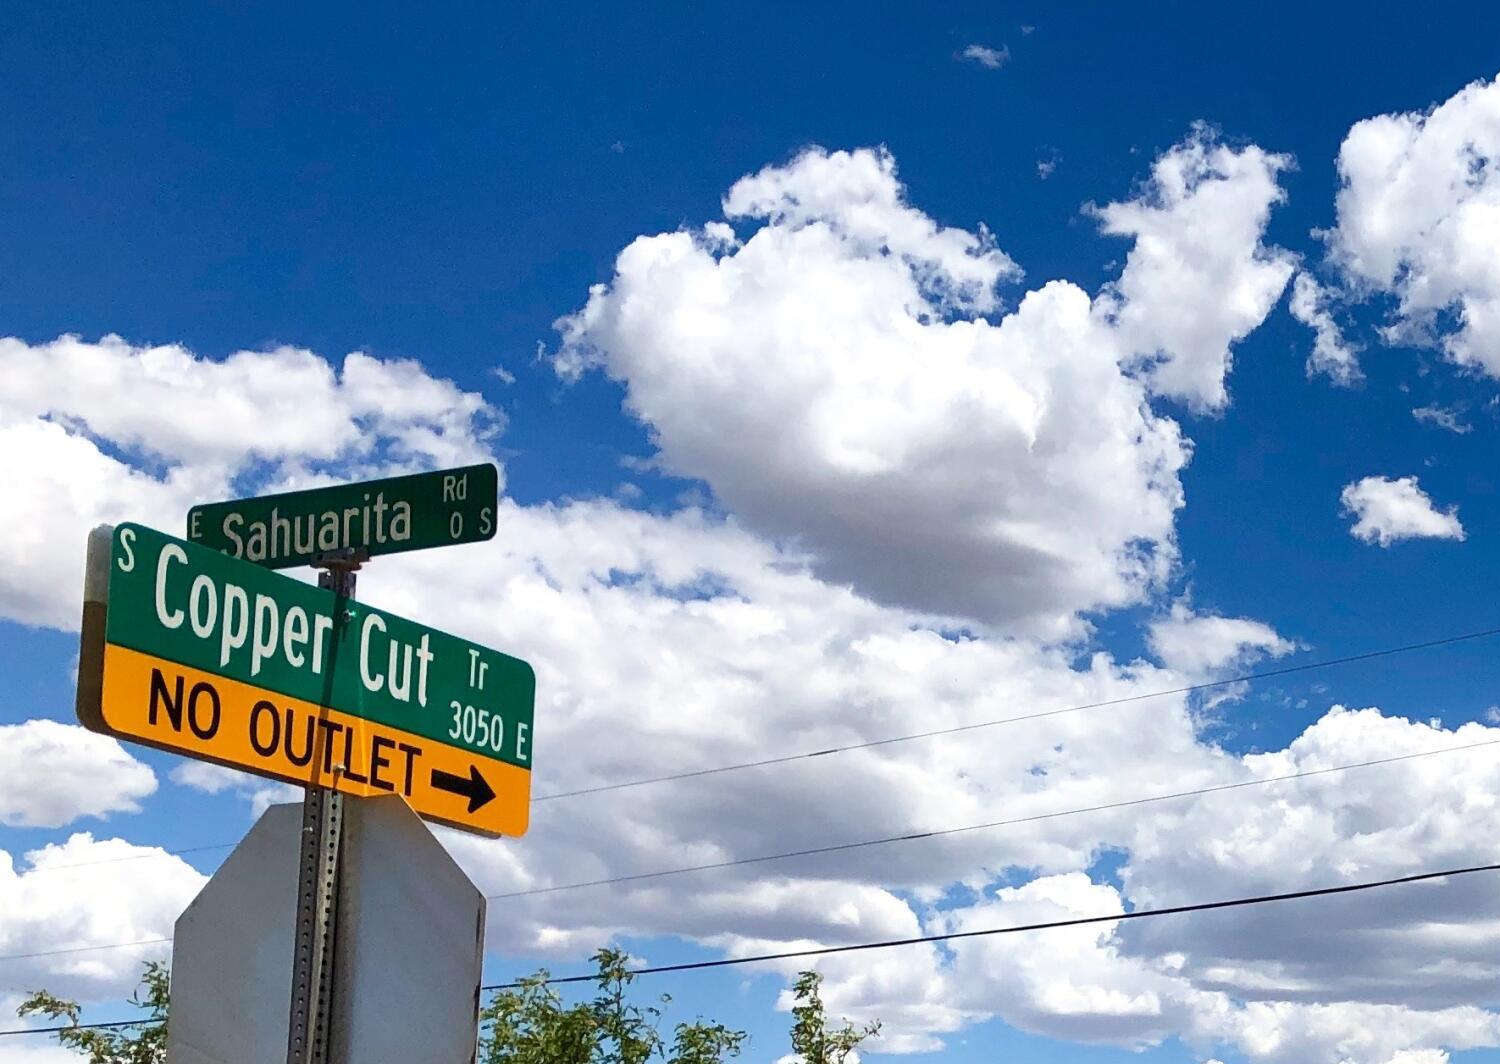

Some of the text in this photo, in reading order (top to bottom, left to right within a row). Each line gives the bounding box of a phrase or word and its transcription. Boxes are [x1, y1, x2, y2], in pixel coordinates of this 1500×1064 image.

[191, 473, 467, 560] E Sahuarita Rd
[479, 507, 492, 535] S
[118, 528, 488, 708] S Copper Cut Tr
[149, 667, 422, 797] NO OUTLET
[449, 701, 529, 761] 3050 E
